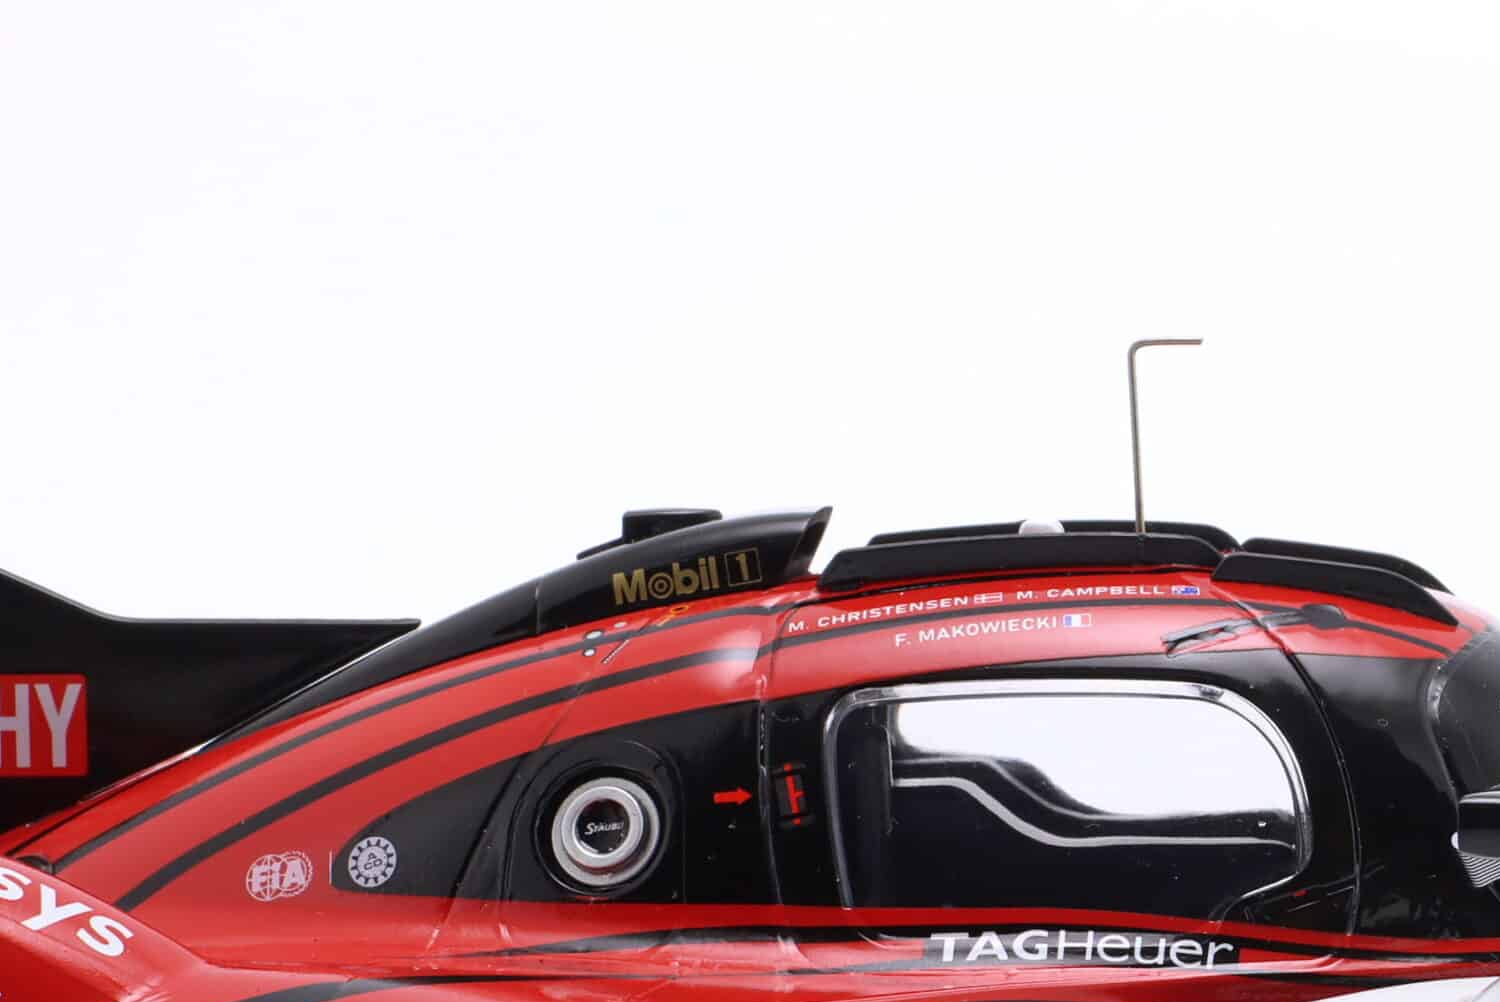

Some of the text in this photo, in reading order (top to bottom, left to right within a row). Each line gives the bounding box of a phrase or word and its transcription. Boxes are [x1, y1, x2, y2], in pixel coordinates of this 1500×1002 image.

[612, 555, 720, 606] Mobil
[1016, 585, 1165, 600] M. CAMPBELL
[788, 596, 968, 632] M. CHRISTENSEN
[895, 615, 1057, 647] F. MAKOWIECKI
